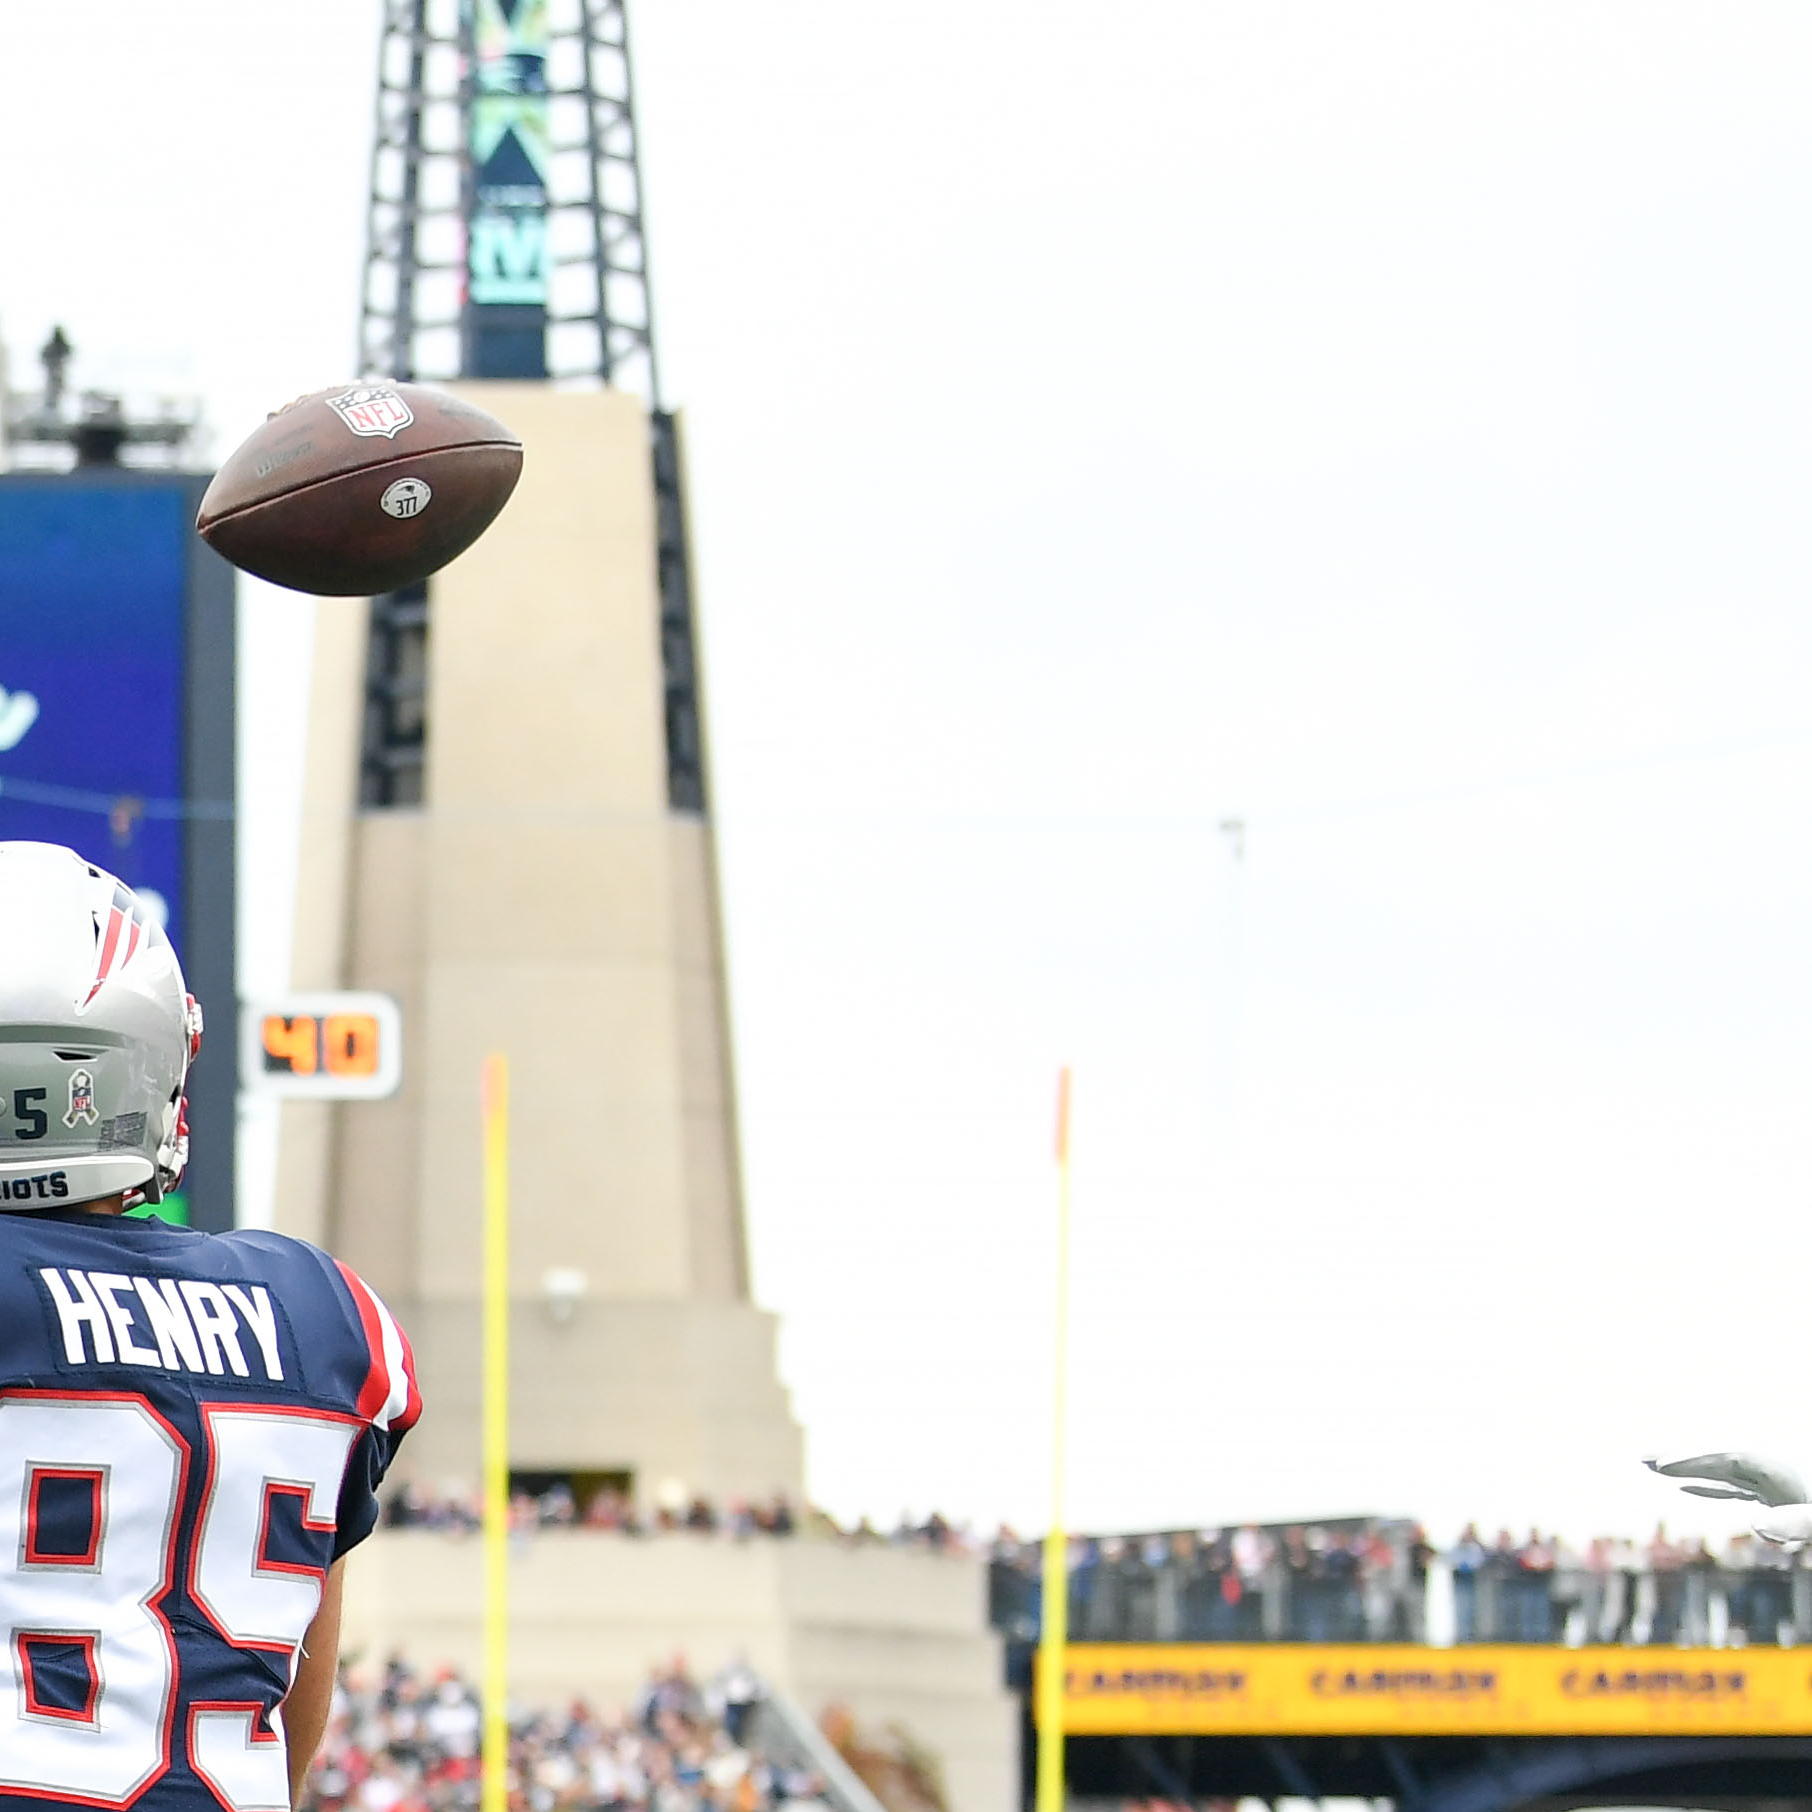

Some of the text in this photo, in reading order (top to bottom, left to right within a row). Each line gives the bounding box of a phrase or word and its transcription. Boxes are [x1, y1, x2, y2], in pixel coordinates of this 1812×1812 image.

[350, 397, 404, 428] NFL
[395, 496, 418, 517] 377
[261, 1012, 379, 1079] 40
[40, 1266, 286, 1382] HENRY
